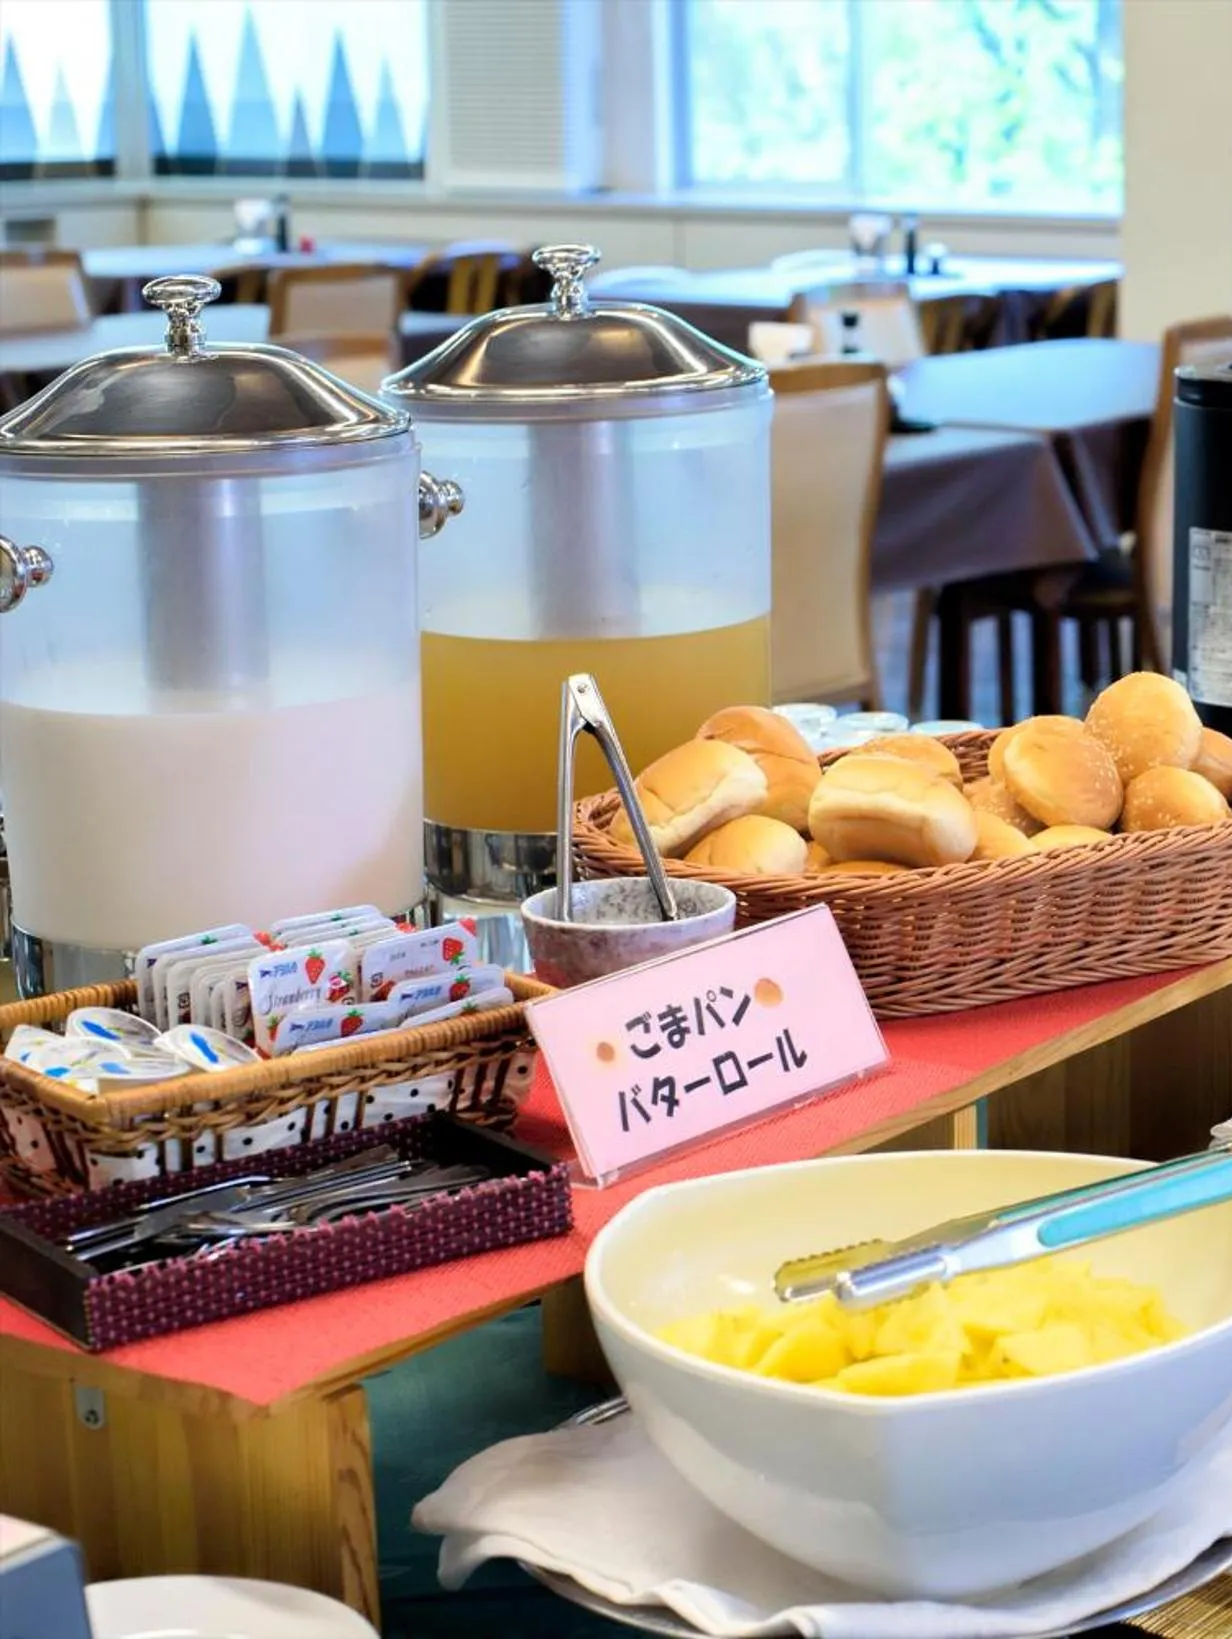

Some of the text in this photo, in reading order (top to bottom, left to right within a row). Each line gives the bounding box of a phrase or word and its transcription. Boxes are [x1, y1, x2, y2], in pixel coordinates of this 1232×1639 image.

[625, 986, 751, 1059] ごまパン
[618, 1029, 808, 1132] バターロール
